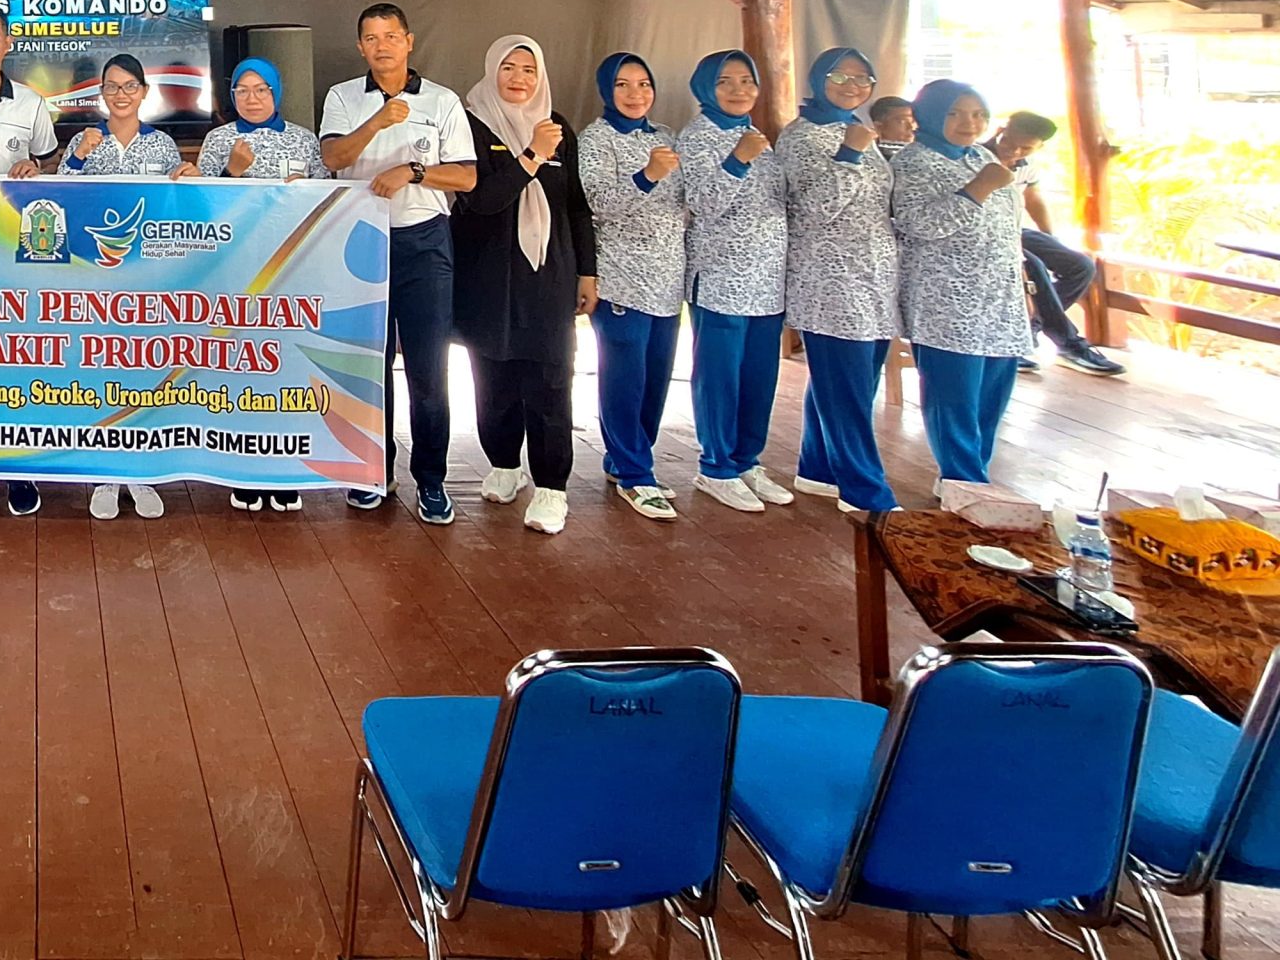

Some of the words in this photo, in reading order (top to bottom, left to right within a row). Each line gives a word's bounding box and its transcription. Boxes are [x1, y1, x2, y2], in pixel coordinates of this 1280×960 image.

[11, 22, 120, 36] SIMEULUE
[17, 42, 45, 52] FANI
[142, 222, 232, 241] GERMAS
[174, 242, 216, 251] Masyarakat
[38, 290, 322, 329] PENGENDALIAN
[81, 336, 280, 373] PRIORITAS
[30, 380, 101, 408] Stroke,
[104, 380, 233, 413] Uronefrologi,
[237, 388, 277, 411] dan
[77, 426, 201, 449] KABUPATEN
[206, 431, 311, 455] SIMEULUE
